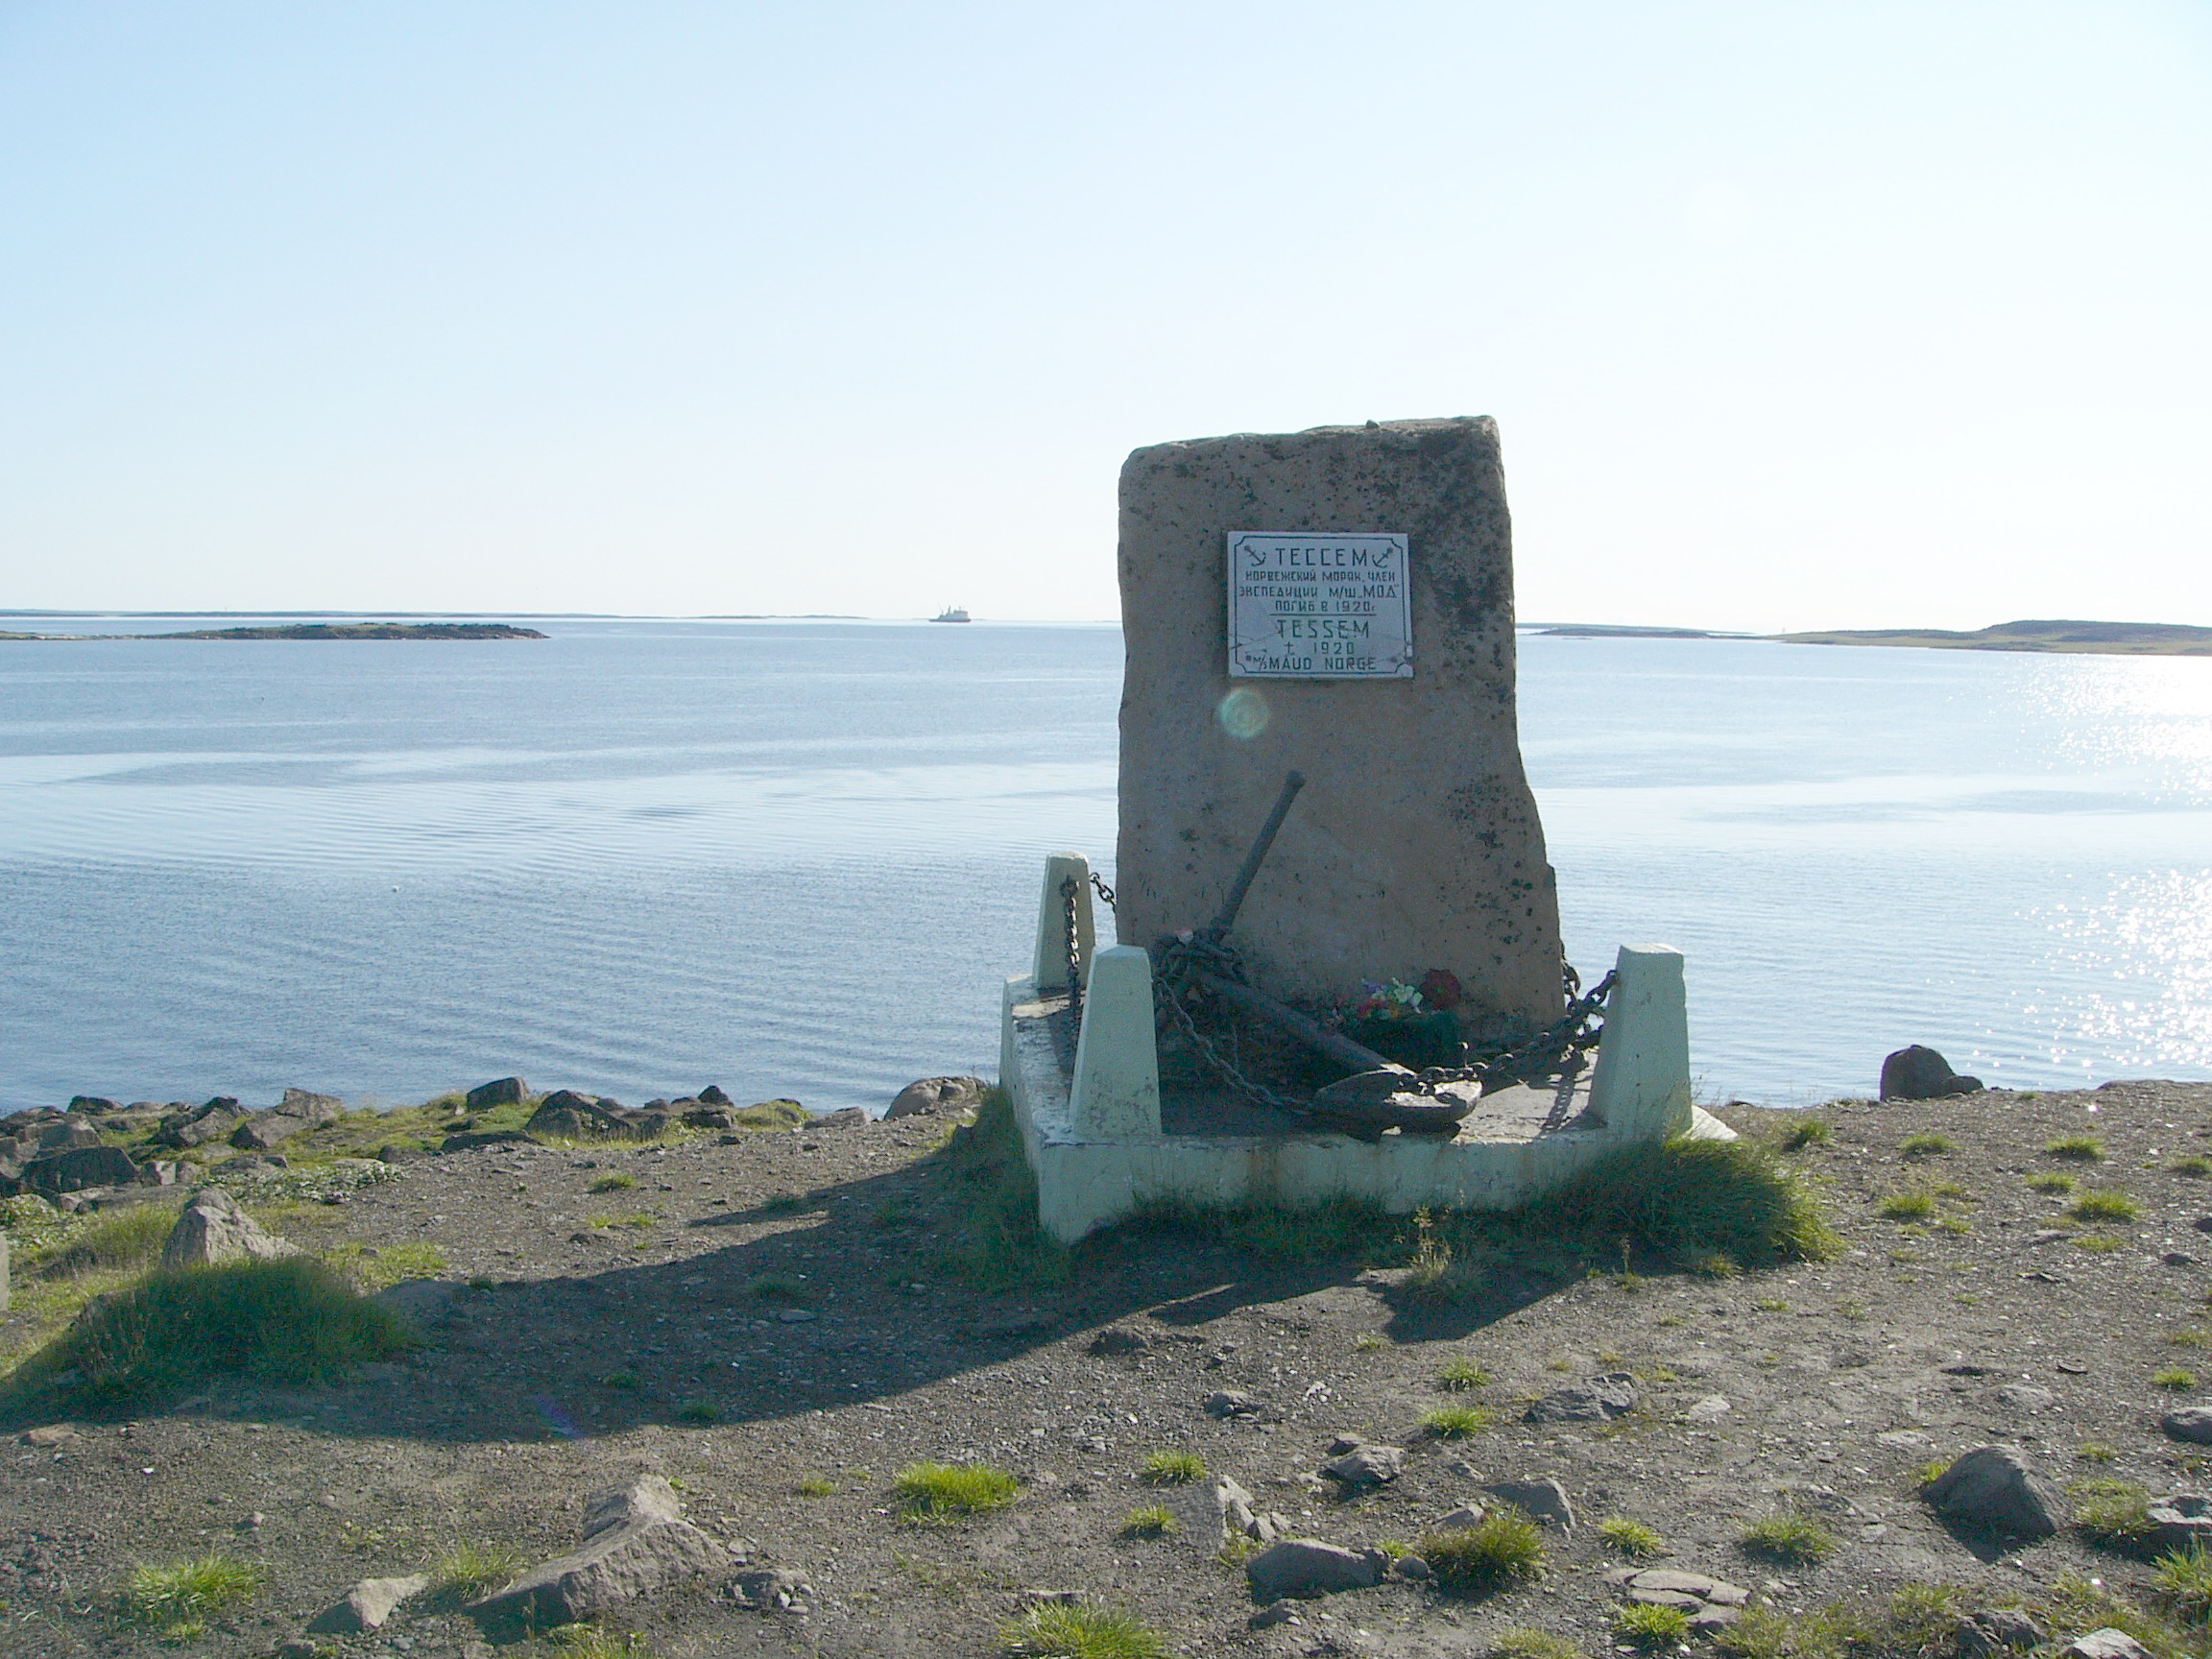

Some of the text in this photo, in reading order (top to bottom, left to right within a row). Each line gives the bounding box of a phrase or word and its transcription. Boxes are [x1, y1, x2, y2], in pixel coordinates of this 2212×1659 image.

[1275, 547, 1367, 566] ТЕССЕМ
[1245, 568, 1316, 582] НОРВЕЖСКИЙ
[1367, 570, 1395, 582] ЧЛЕН
[1239, 586, 1318, 598] ЭКСПЕДИЦИИ
[1275, 600, 1315, 612] ПОГИБ
[1321, 600, 1328, 612] В
[1277, 619, 1369, 638] TESSEM
[1313, 641, 1355, 655] 1920
[1269, 656, 1312, 670] MAUD
[1325, 657, 1377, 671] NORGE
